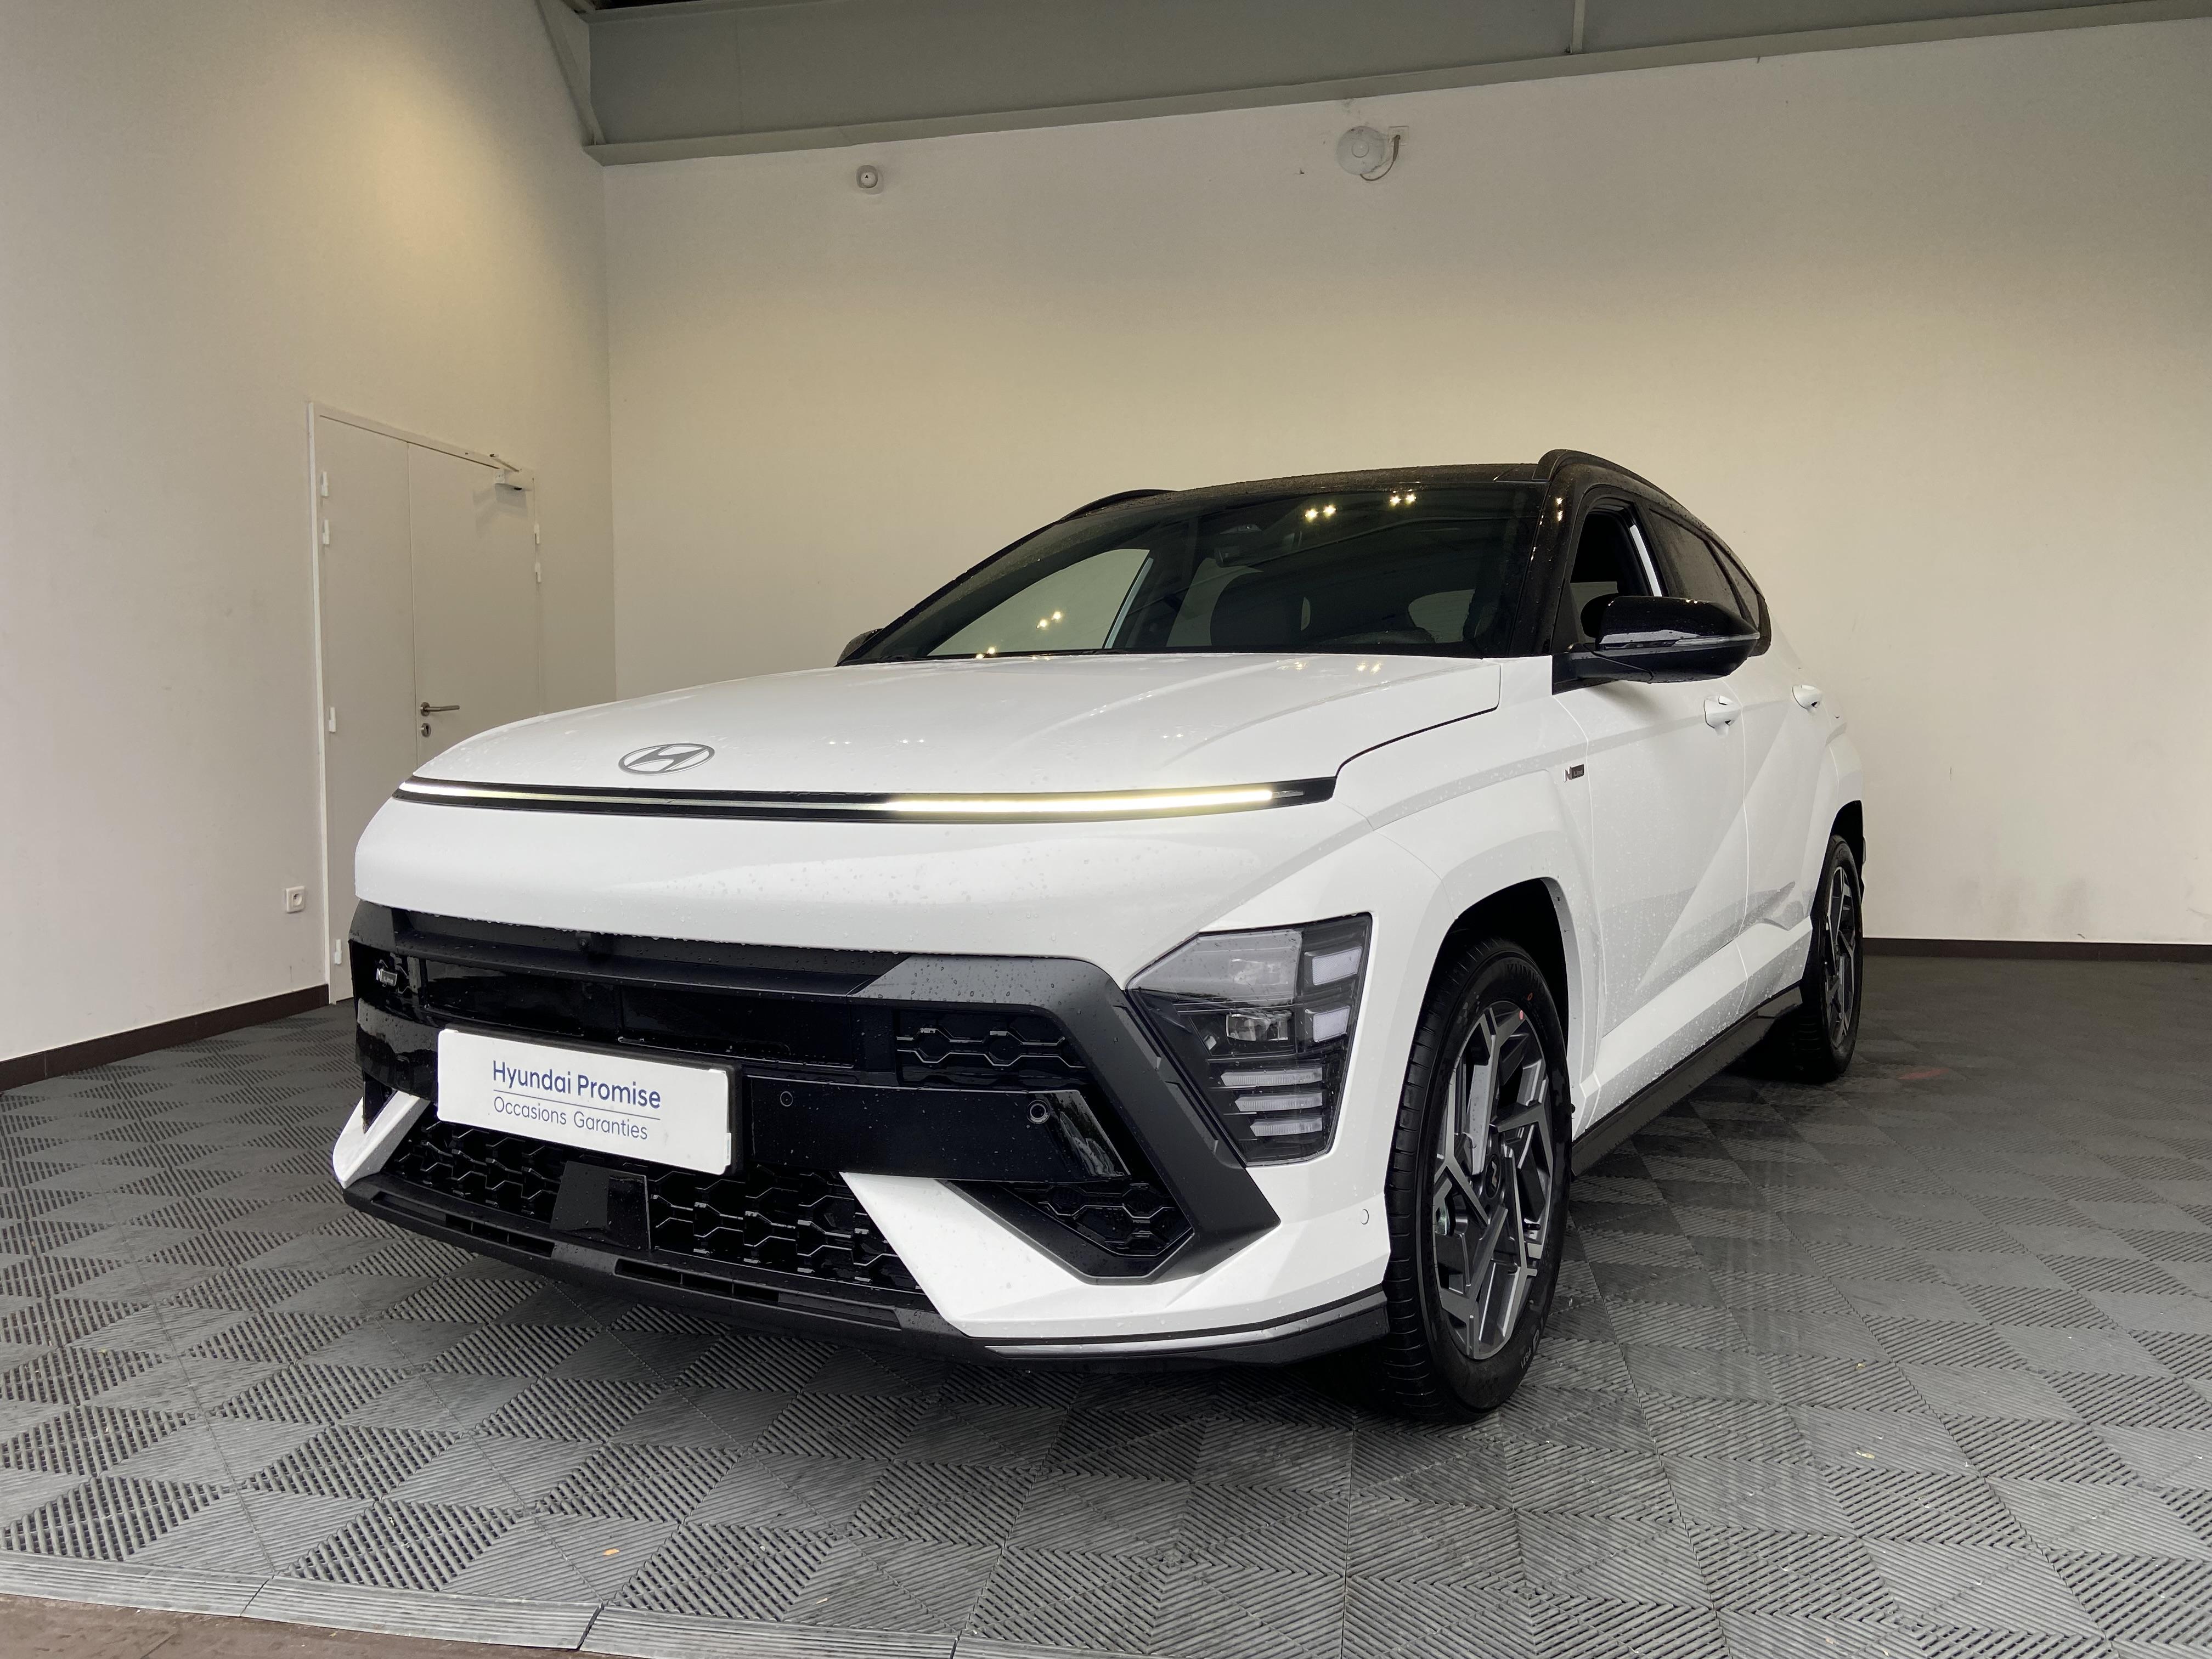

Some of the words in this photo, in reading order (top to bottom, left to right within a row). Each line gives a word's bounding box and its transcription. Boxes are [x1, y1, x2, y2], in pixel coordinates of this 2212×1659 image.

[376, 968, 383, 982] N
[493, 1060, 571, 1095] Hyundai
[577, 1075, 661, 1109] Promise
[494, 1097, 567, 1125] Occasions
[574, 1111, 647, 1140] Garanties
